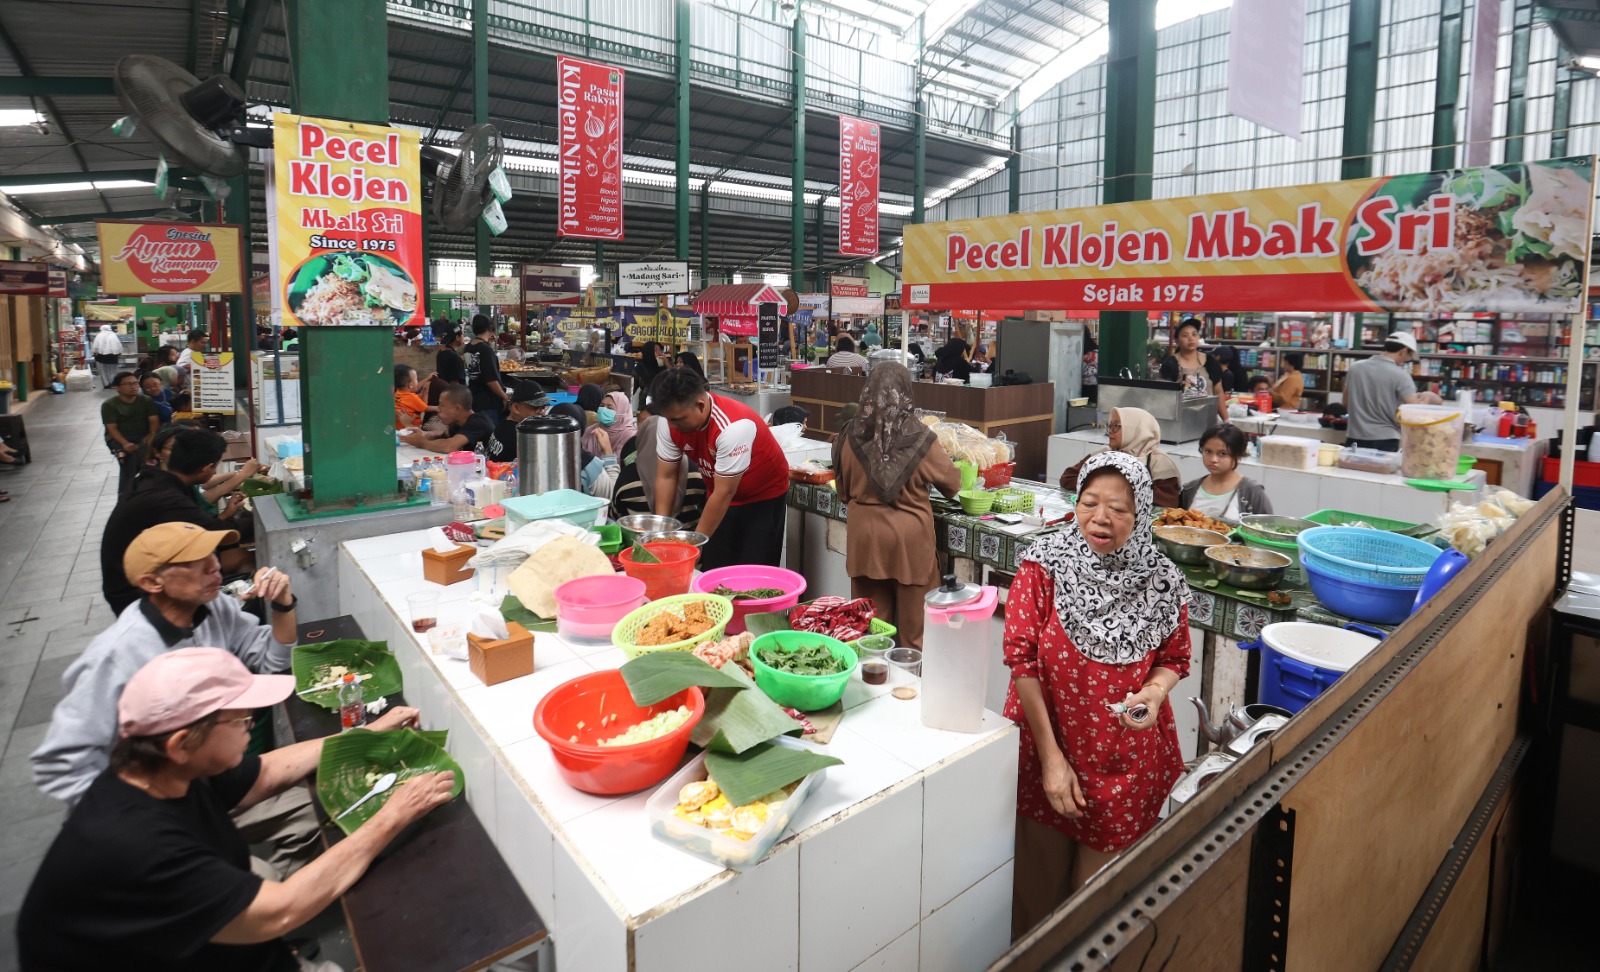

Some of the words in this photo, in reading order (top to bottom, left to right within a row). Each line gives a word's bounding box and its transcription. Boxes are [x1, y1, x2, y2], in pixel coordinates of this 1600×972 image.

[299, 122, 399, 167] Pecel
[290, 160, 409, 203] Klojen
[301, 207, 367, 233] Mbak
[371, 212, 404, 235] Sri
[946, 225, 1032, 274] Pecel
[1042, 220, 1172, 271] Klojen
[1184, 202, 1339, 262] Mbak
[1356, 193, 1456, 256] Sri
[112, 234, 201, 264] Ayam
[166, 228, 212, 243] Spesial
[310, 235, 358, 250] Since
[362, 240, 397, 251] 1975
[151, 257, 219, 274] Kampung
[1083, 283, 1143, 306] Sejak
[1153, 284, 1204, 303] 1975
